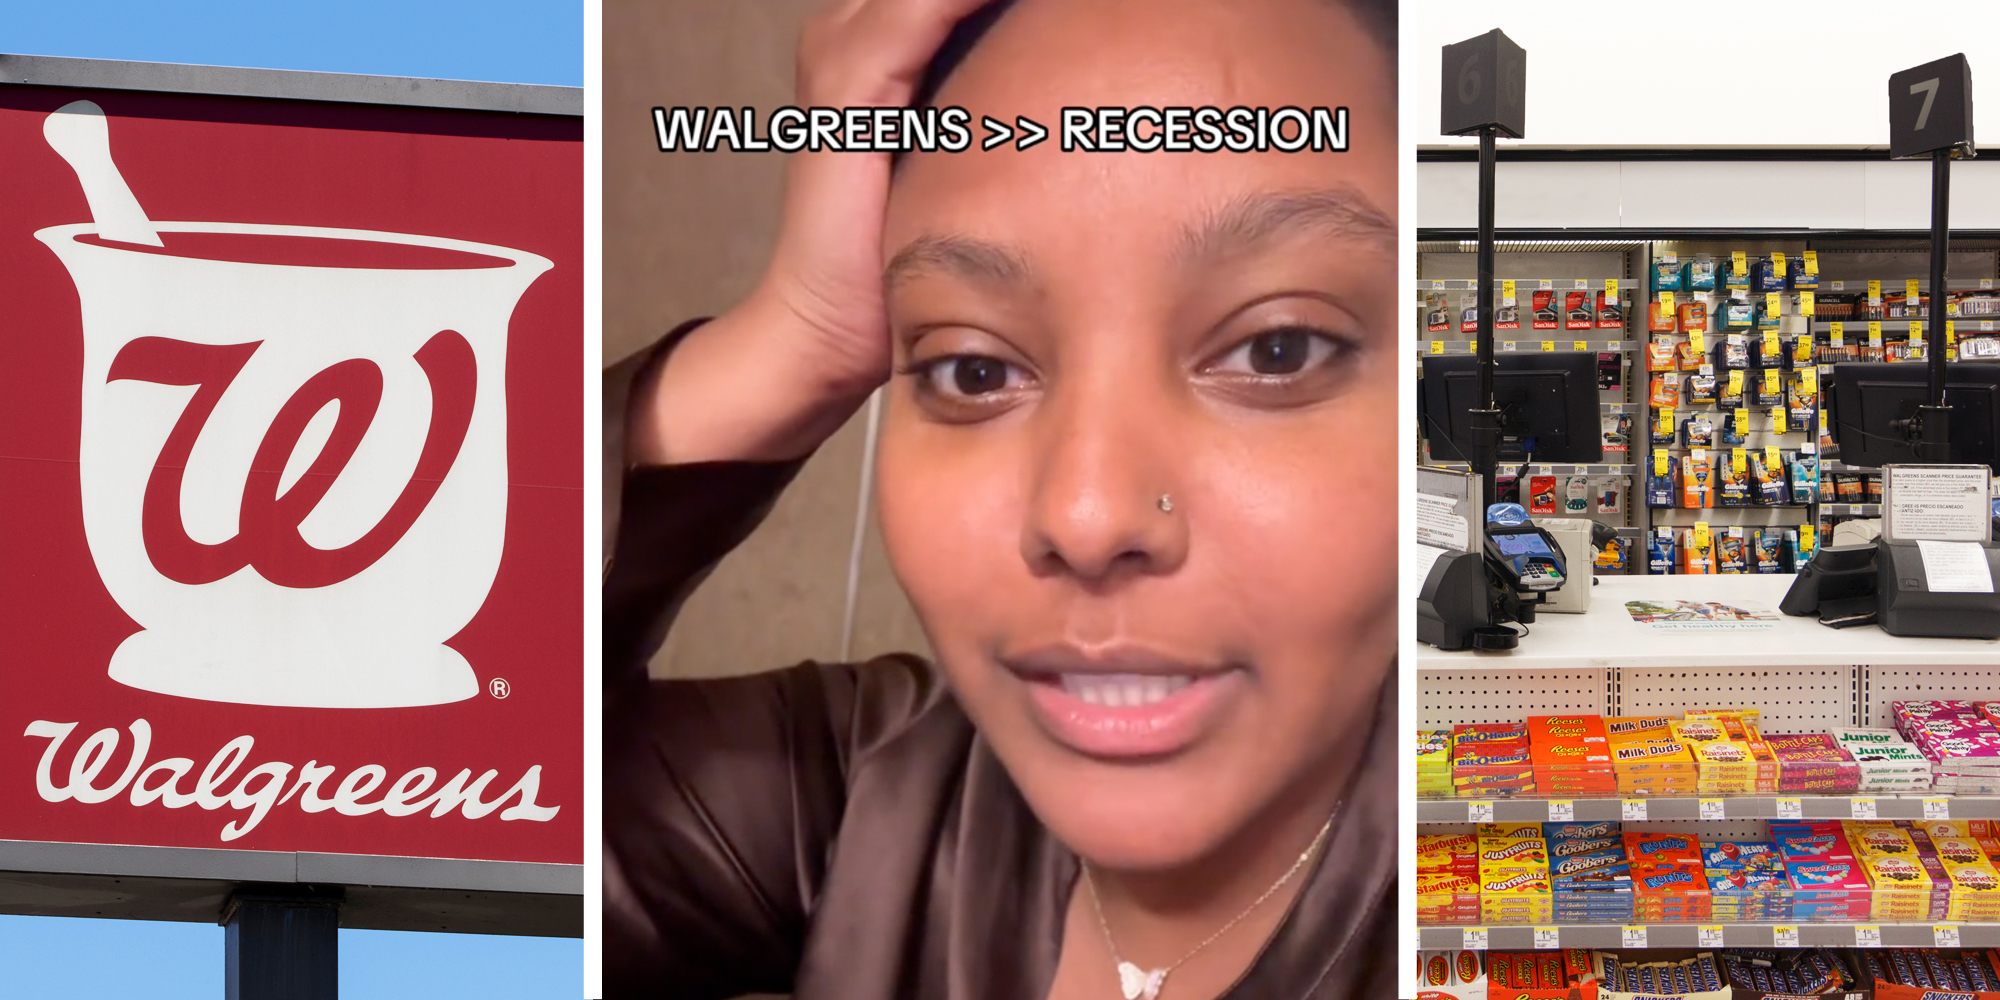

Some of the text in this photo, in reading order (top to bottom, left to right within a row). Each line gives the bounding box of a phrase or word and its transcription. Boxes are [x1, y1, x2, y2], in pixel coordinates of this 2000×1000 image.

[1458, 52, 1481, 105] 6
[1909, 77, 1940, 131] 7
[106, 329, 477, 589] W
[1609, 717, 1670, 733] Milk Duds
[1840, 733, 1891, 742] Junior
[1550, 745, 1591, 753] Reese's
[1617, 743, 1682, 759] Milk Duds
[1701, 749, 1747, 757] Raisinets
[1855, 747, 1907, 755] Junior
[23, 718, 562, 842] Walgreens
[1554, 840, 1612, 857] Goobers
[1637, 838, 1688, 855] RUNTS
[1863, 837, 1909, 845] Raisinets
[1482, 840, 1543, 860] JUJYFRUITS
[1738, 844, 1768, 856] HEADS
[1940, 846, 1980, 855] aisinets
[1559, 855, 1618, 874] Goobers
[1873, 864, 1921, 872] Raisinets
[1484, 873, 1546, 891] JUJYFRUITS
[1642, 871, 1694, 890] RUNTS
